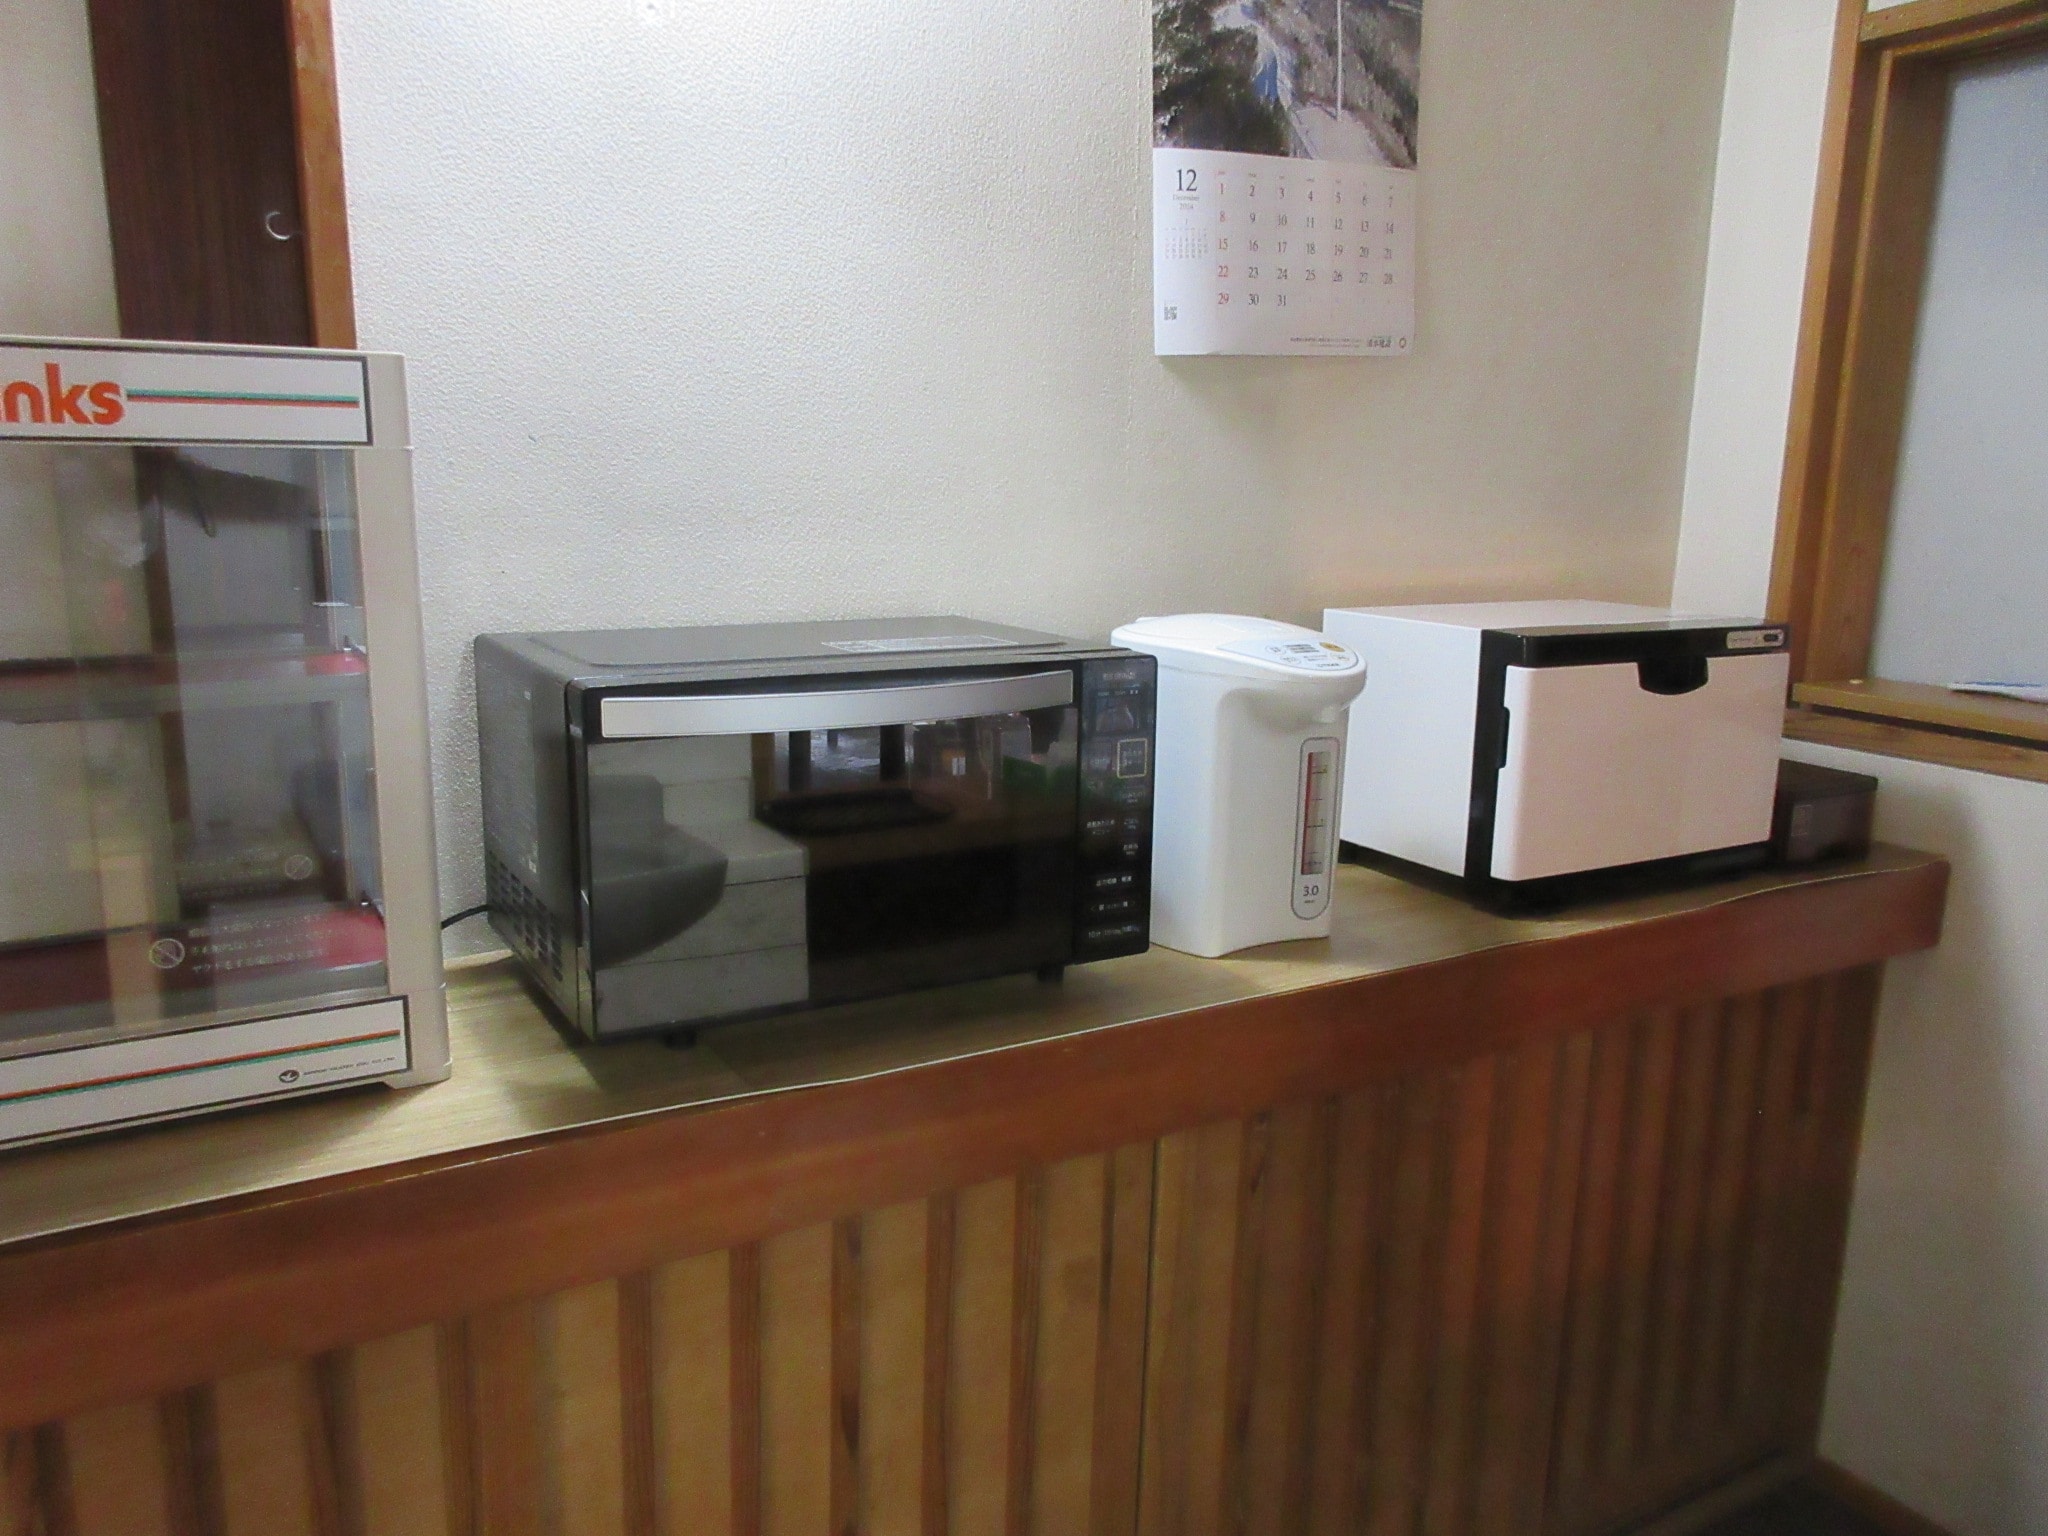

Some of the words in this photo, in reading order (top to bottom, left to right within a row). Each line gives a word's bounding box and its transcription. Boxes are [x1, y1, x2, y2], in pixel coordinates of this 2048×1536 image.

[1176, 168, 1198, 192] 12
[1249, 184, 1256, 197] 2
[1279, 186, 1285, 200] 3
[1307, 189, 1314, 202] 4
[1335, 191, 1341, 204] 5
[1362, 194, 1368, 207] 6
[1388, 195, 1394, 208] 7
[1219, 210, 1226, 223] 8
[1249, 211, 1256, 224] 9
[1278, 213, 1288, 226] 10
[1306, 216, 1315, 229] 11
[1334, 217, 1343, 231] 12
[1361, 220, 1369, 233] 13
[1386, 221, 1394, 234] 14
[1218, 238, 1229, 250] 15
[1248, 239, 1259, 252] 16
[1278, 241, 1288, 253] 17
[1306, 241, 1316, 255] 18
[1334, 243, 1344, 256] 19
[1359, 245, 1369, 258] 20
[1383, 247, 1393, 259] 21
[1218, 265, 1229, 278] 22
[1248, 266, 1259, 279] 23
[1277, 267, 1288, 280] 24
[1305, 268, 1316, 281] 25
[1332, 270, 1343, 282] 26
[1359, 271, 1369, 284] 27
[1383, 272, 1393, 285] 28
[1218, 292, 1230, 305] 29
[1248, 293, 1260, 306] 30
[1277, 294, 1287, 307] 31
[3, 362, 126, 425] nks
[1302, 885, 1320, 897] 3.0
